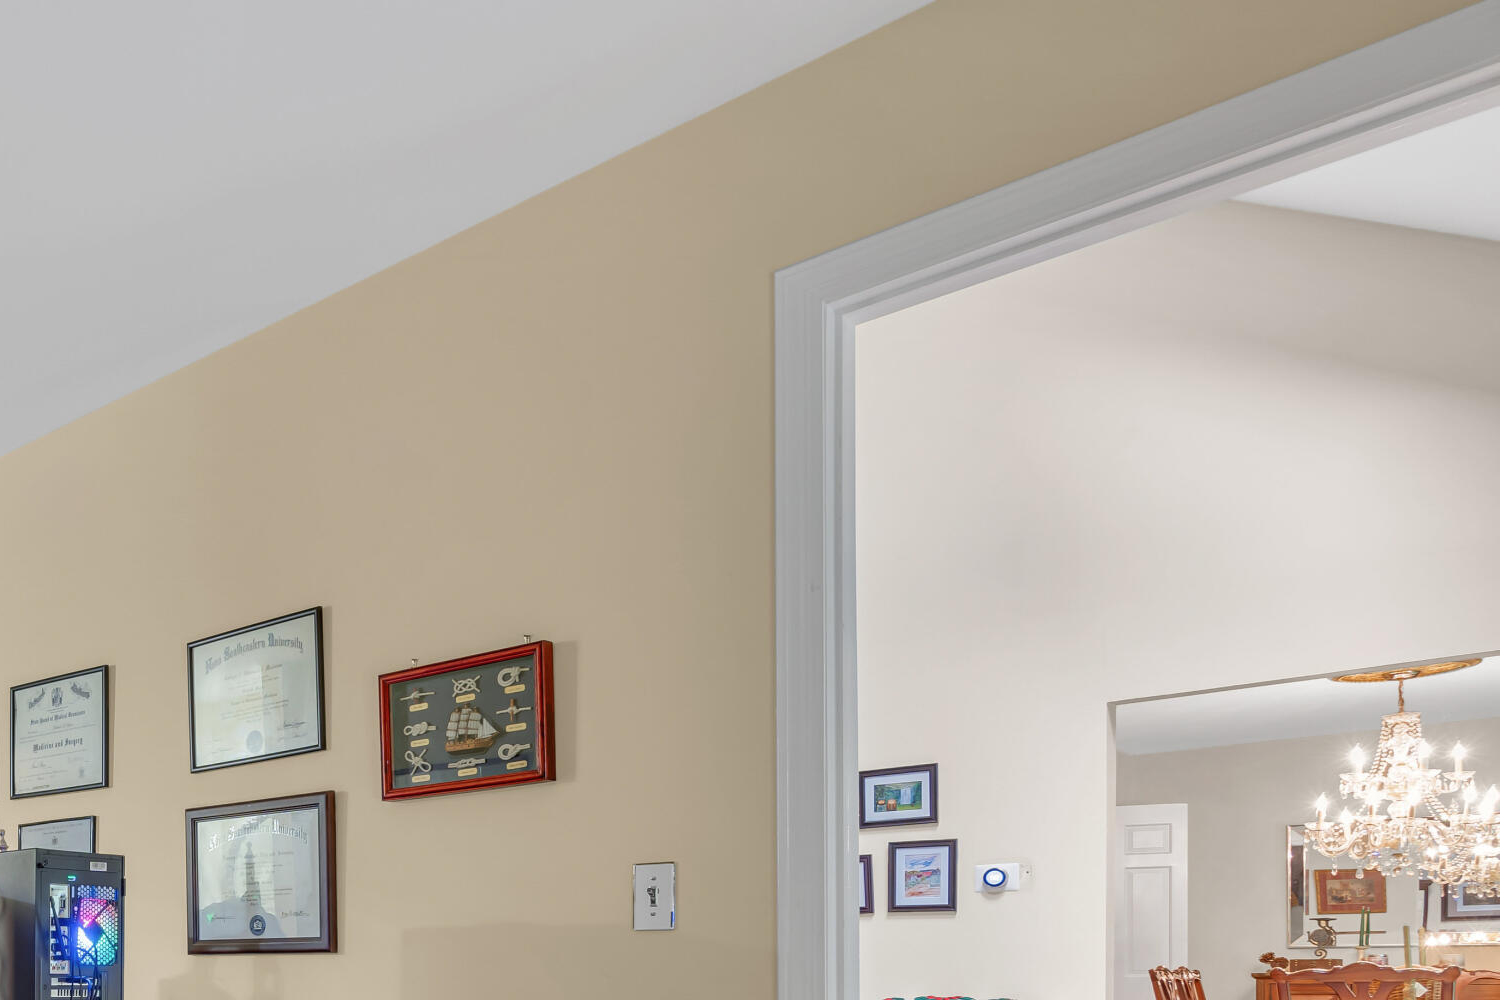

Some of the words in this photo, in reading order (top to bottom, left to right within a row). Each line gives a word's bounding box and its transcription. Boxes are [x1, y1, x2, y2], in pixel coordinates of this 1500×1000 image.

[267, 632, 304, 654] University
[33, 742, 54, 753] Medicine
[55, 740, 64, 749] and
[65, 737, 83, 749] Surgery
